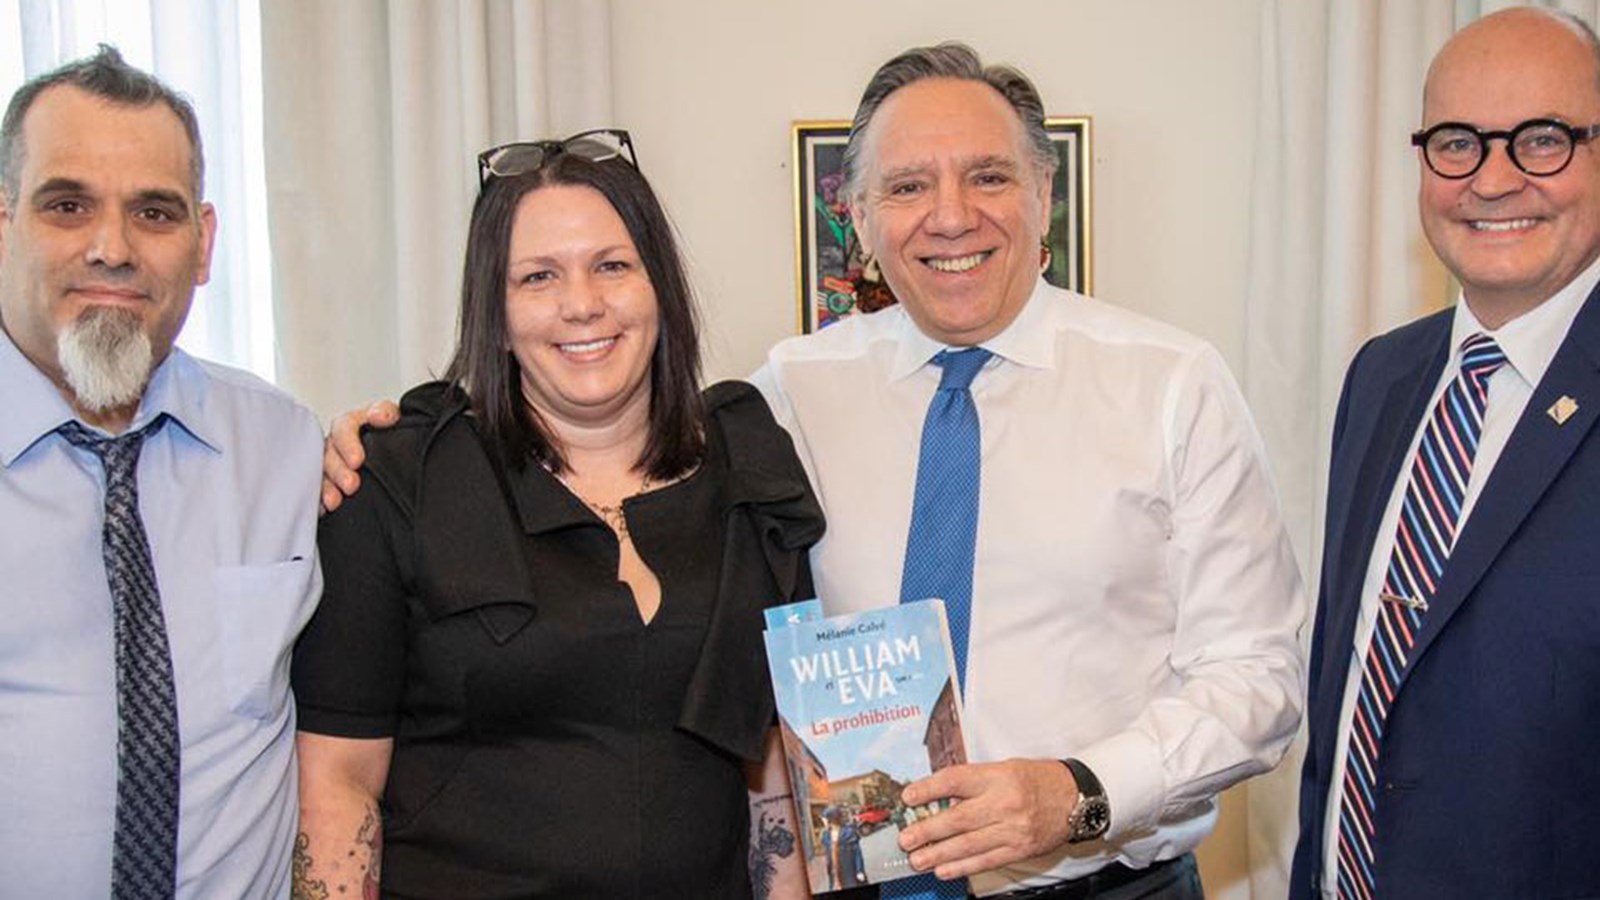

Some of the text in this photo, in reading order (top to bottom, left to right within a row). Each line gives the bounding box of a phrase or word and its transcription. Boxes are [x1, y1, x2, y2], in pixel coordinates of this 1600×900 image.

[816, 620, 886, 641] Mélanie Calvé
[789, 635, 922, 684] WILLIAM
[838, 670, 898, 704] EVA
[811, 705, 921, 736] La prohibition
